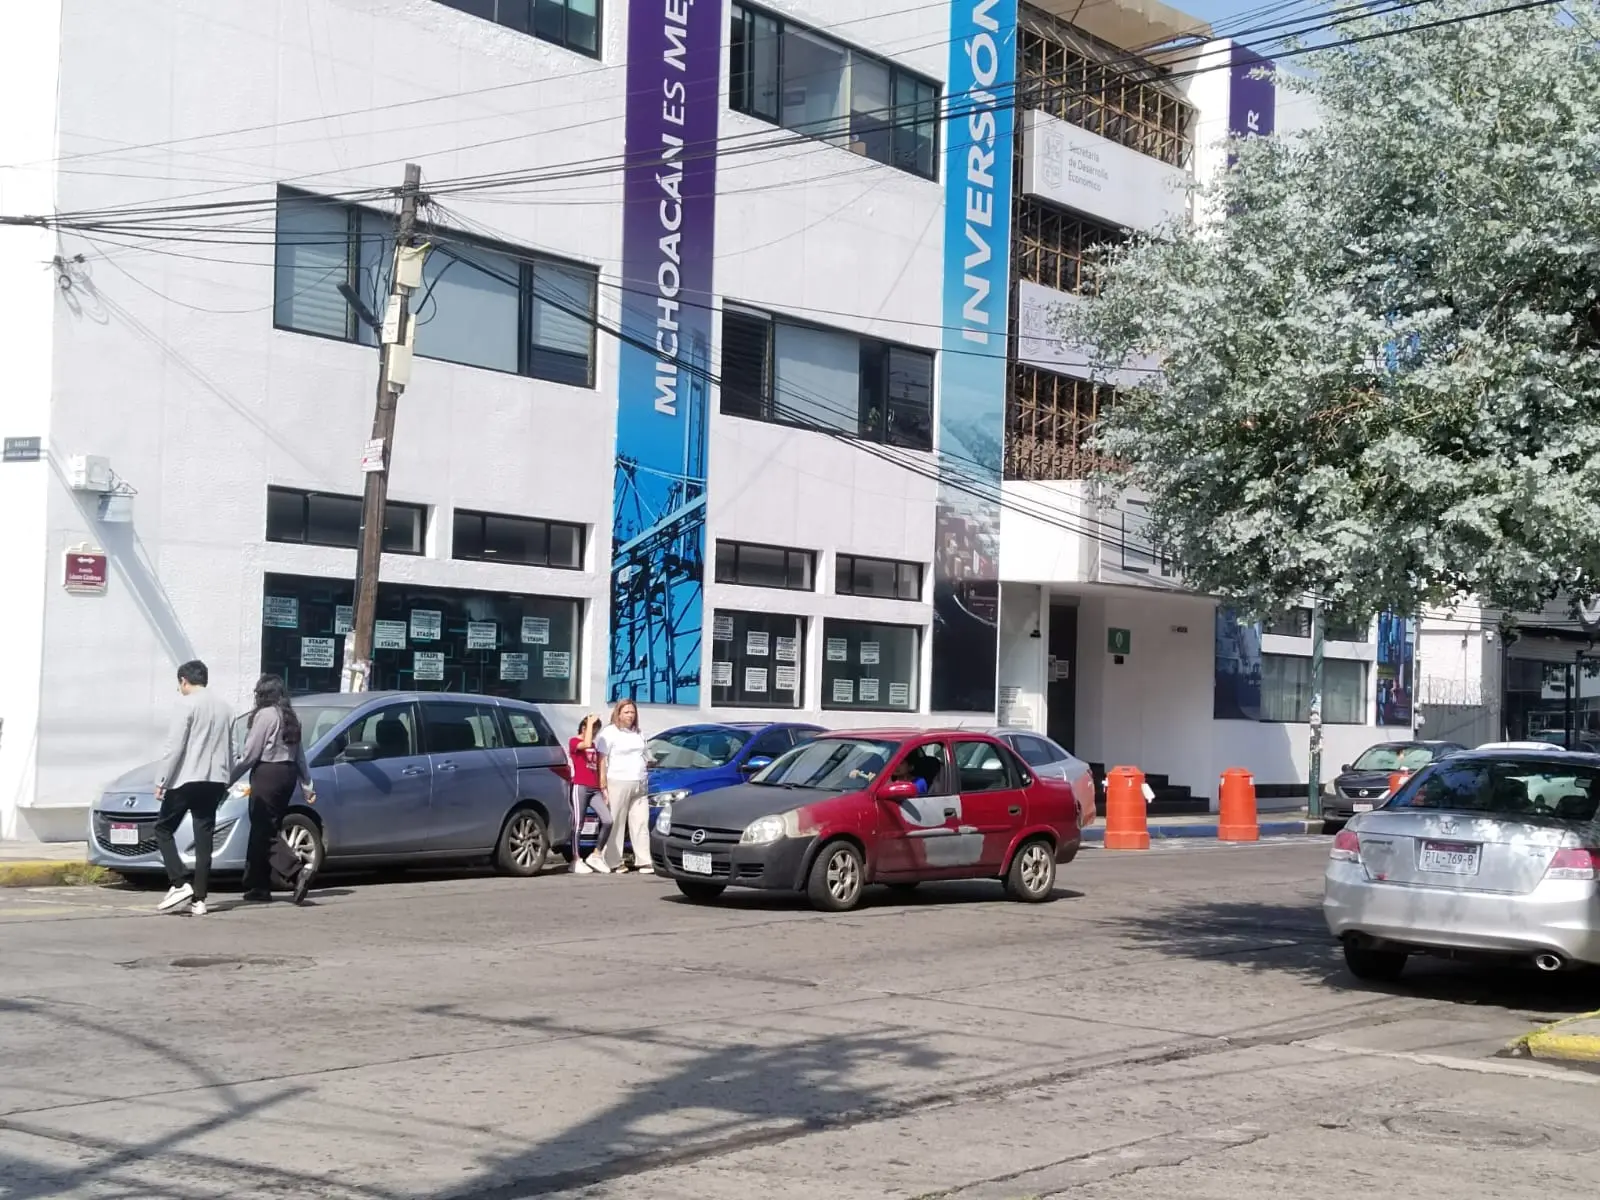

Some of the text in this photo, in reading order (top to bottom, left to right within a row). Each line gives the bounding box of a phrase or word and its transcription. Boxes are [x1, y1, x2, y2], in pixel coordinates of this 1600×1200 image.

[655, 0, 694, 417] MICHOACÁN ES ME
